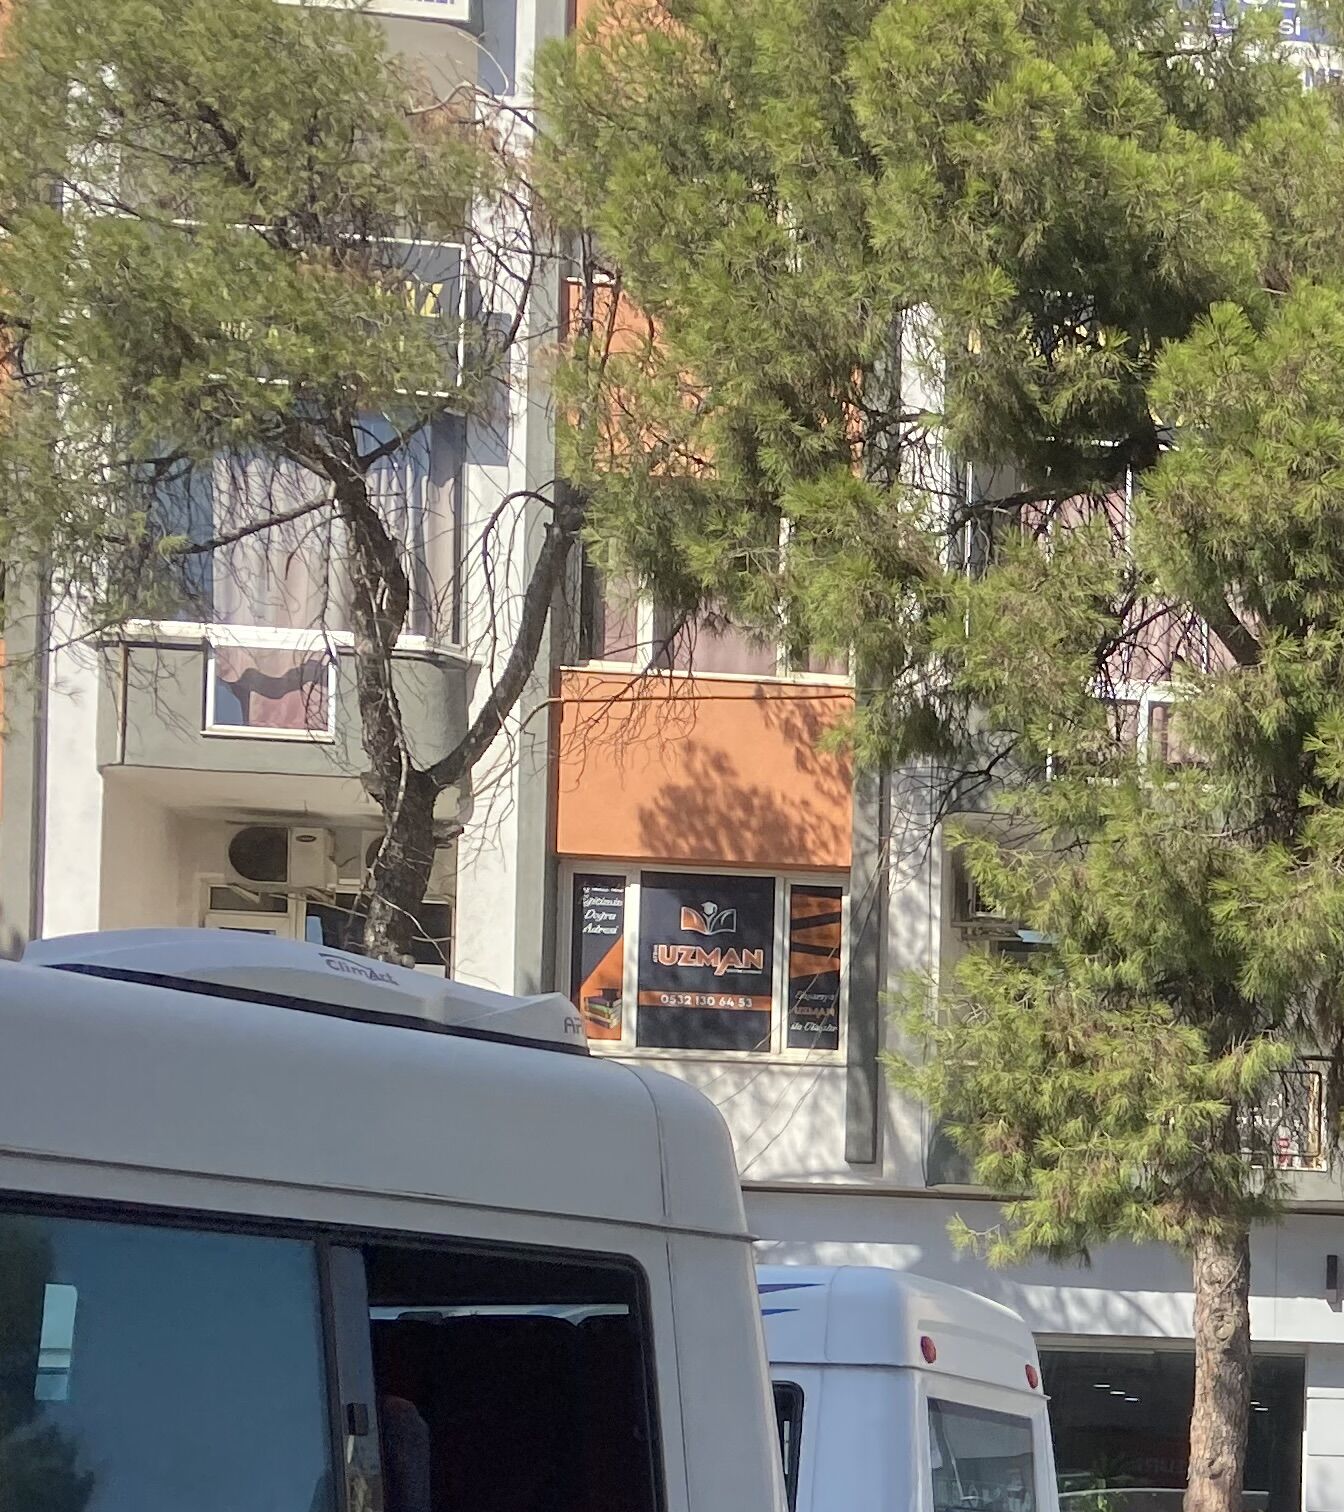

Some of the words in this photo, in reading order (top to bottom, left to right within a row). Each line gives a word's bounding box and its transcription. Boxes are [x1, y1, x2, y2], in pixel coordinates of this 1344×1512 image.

[658, 944, 765, 977] UZMAN
[661, 994, 692, 1006] 0532
[695, 996, 716, 1006] 130
[719, 997, 735, 1007] 64
[738, 998, 753, 1008] 53
